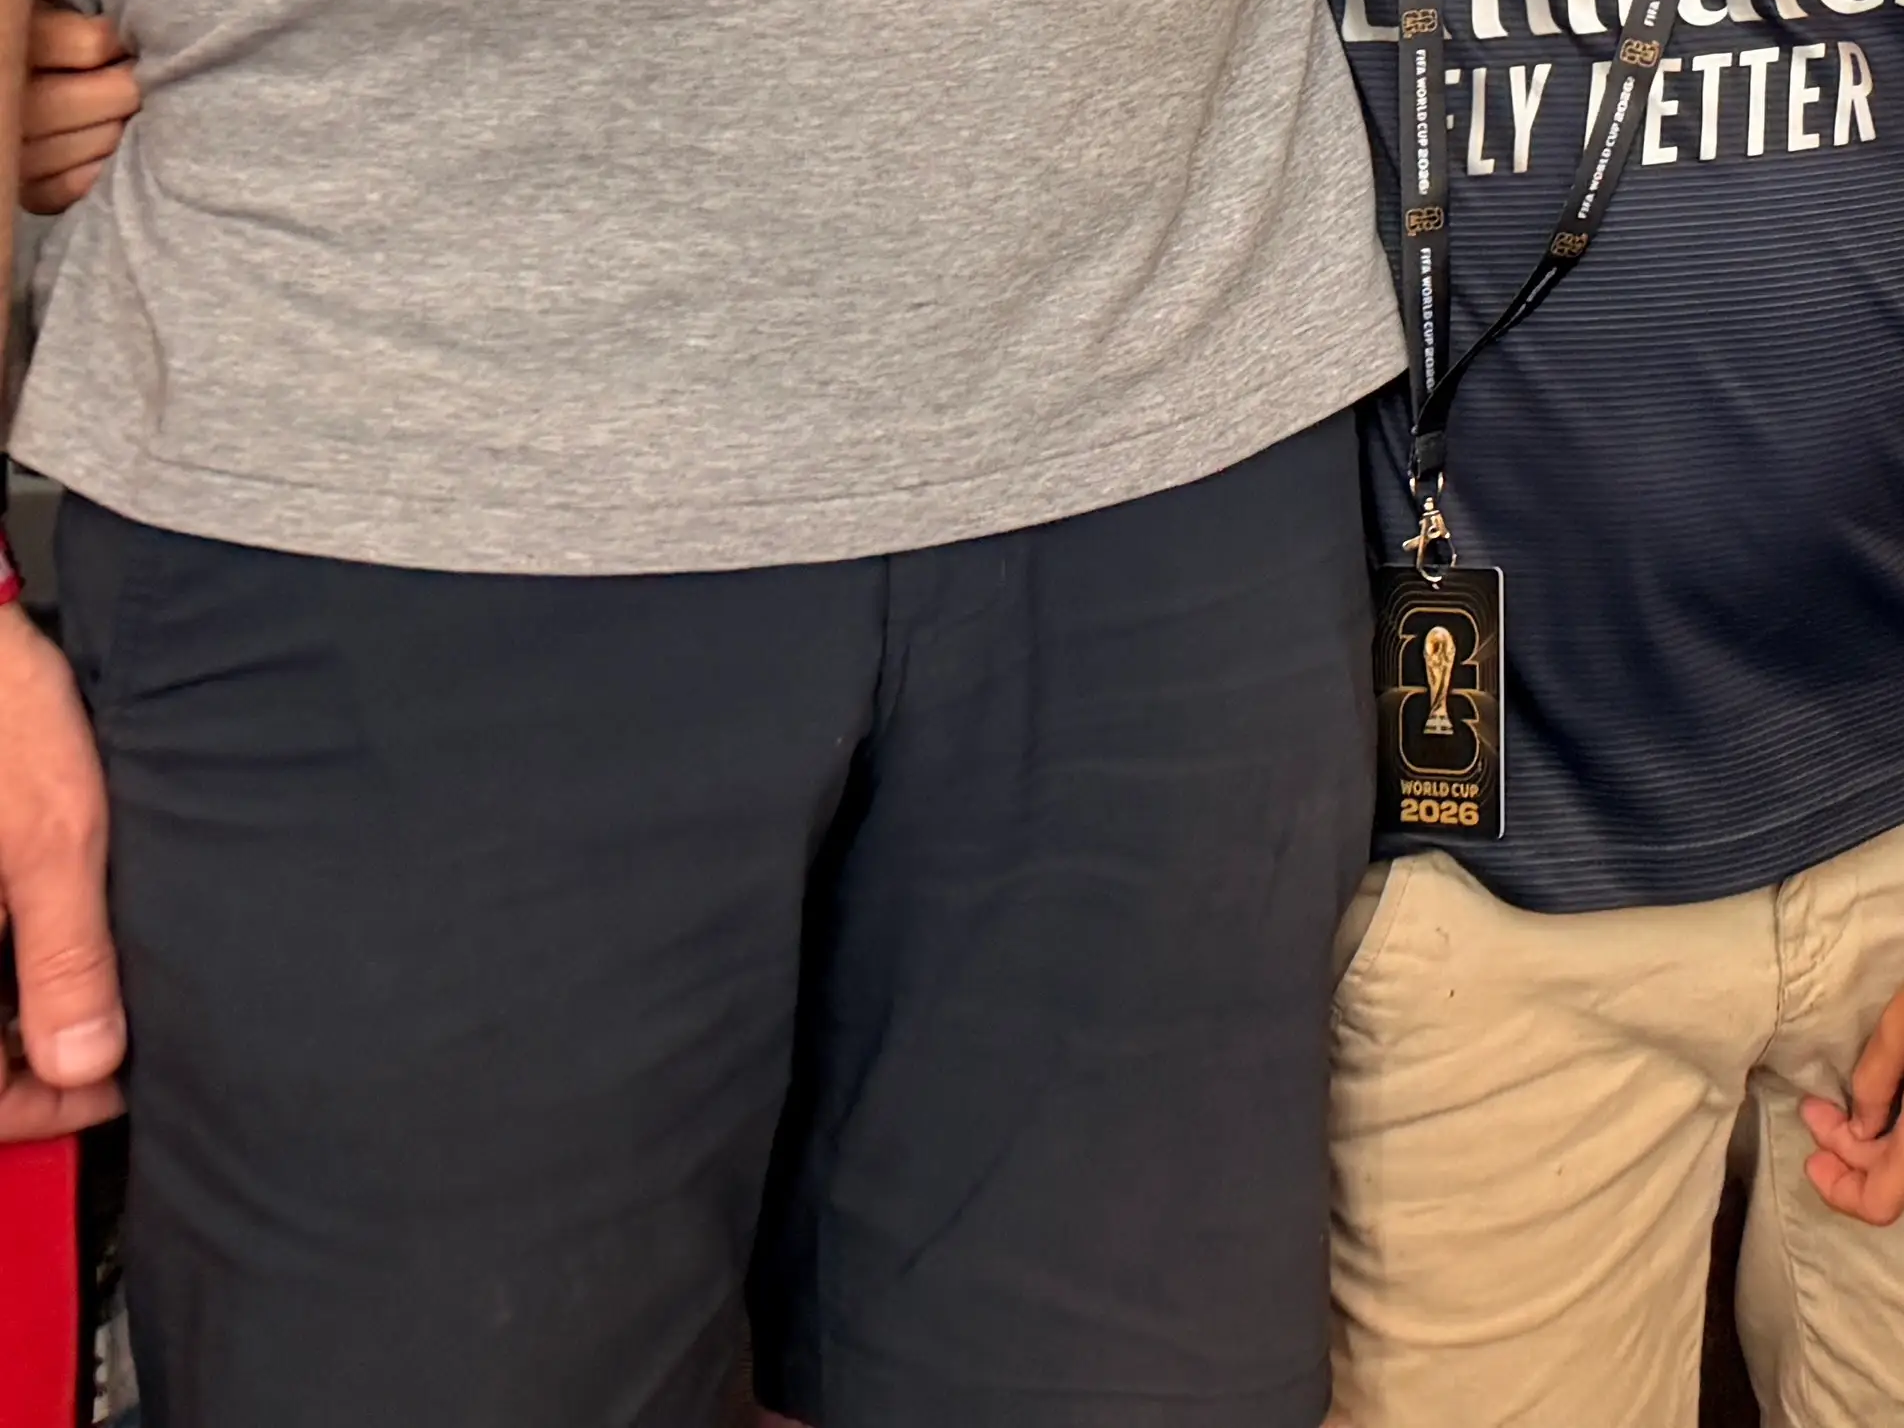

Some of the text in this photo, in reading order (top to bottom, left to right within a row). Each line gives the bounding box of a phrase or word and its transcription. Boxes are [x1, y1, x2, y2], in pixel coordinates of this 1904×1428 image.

[1400, 779, 1479, 798] WORLD CUP
[1400, 798, 1480, 826] 2026
